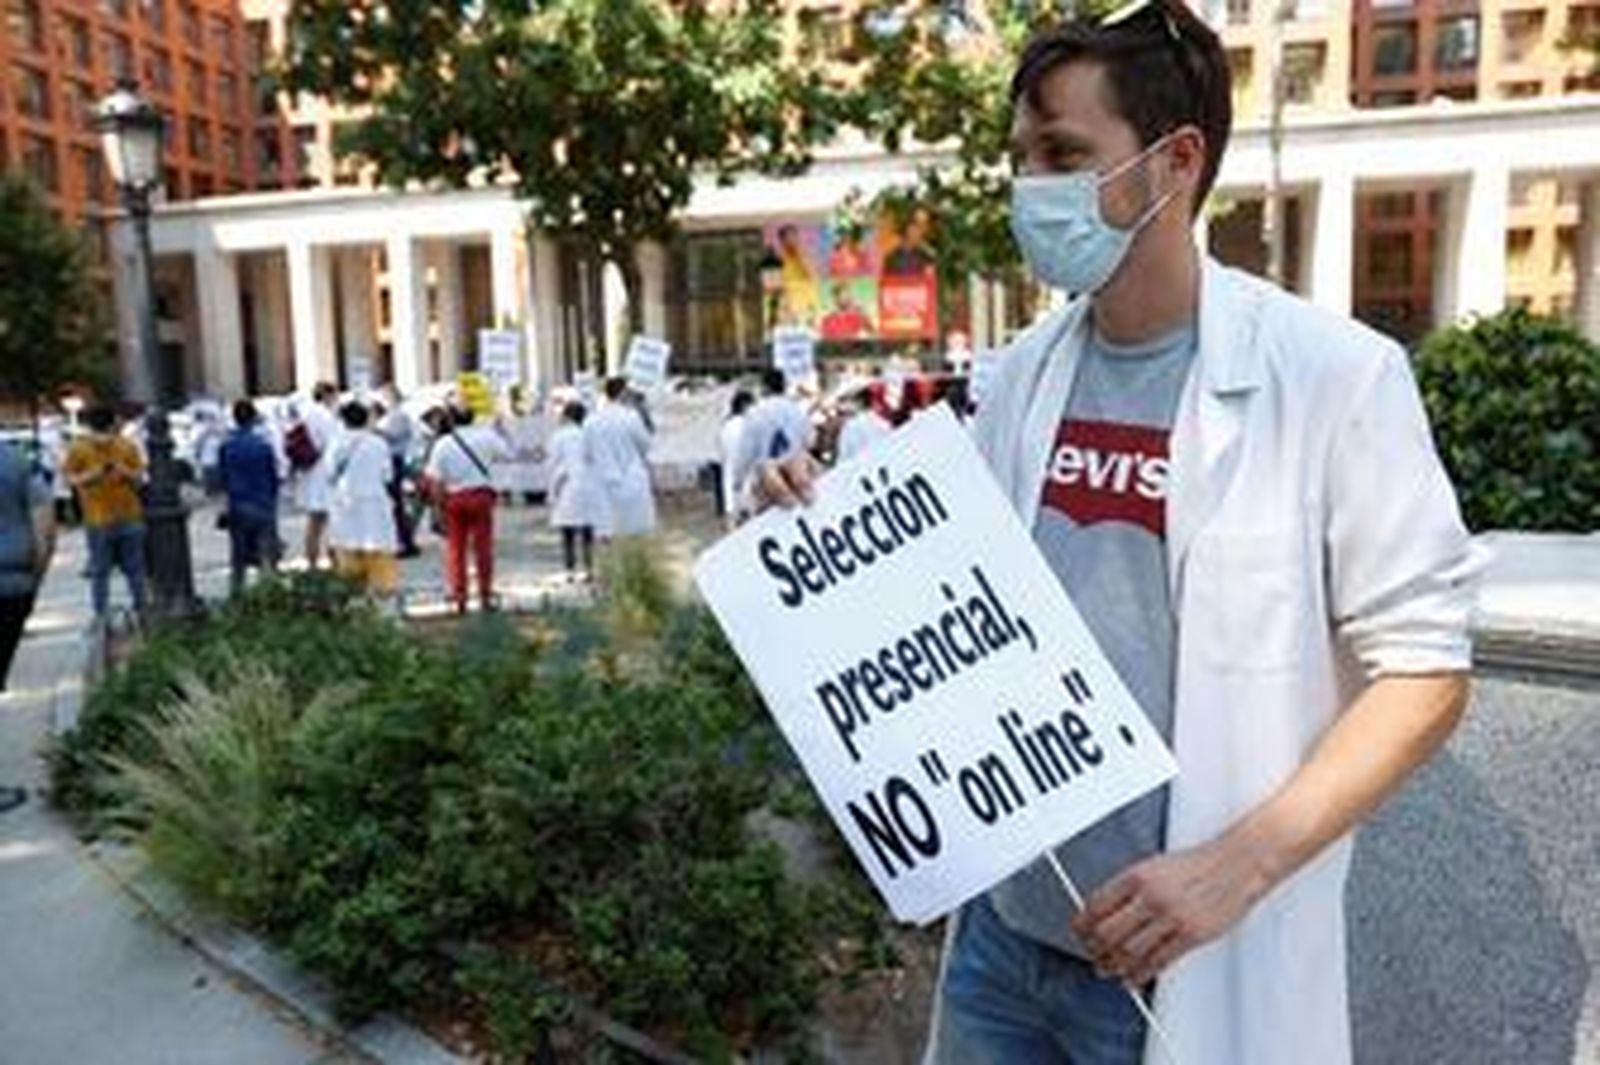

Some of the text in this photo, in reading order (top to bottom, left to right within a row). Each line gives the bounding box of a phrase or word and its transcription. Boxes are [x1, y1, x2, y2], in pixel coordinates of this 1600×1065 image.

[1047, 445, 1170, 499] evi's
[759, 466, 948, 608] Selección
[815, 566, 1038, 763] presencial,
[849, 775, 943, 880] NO
